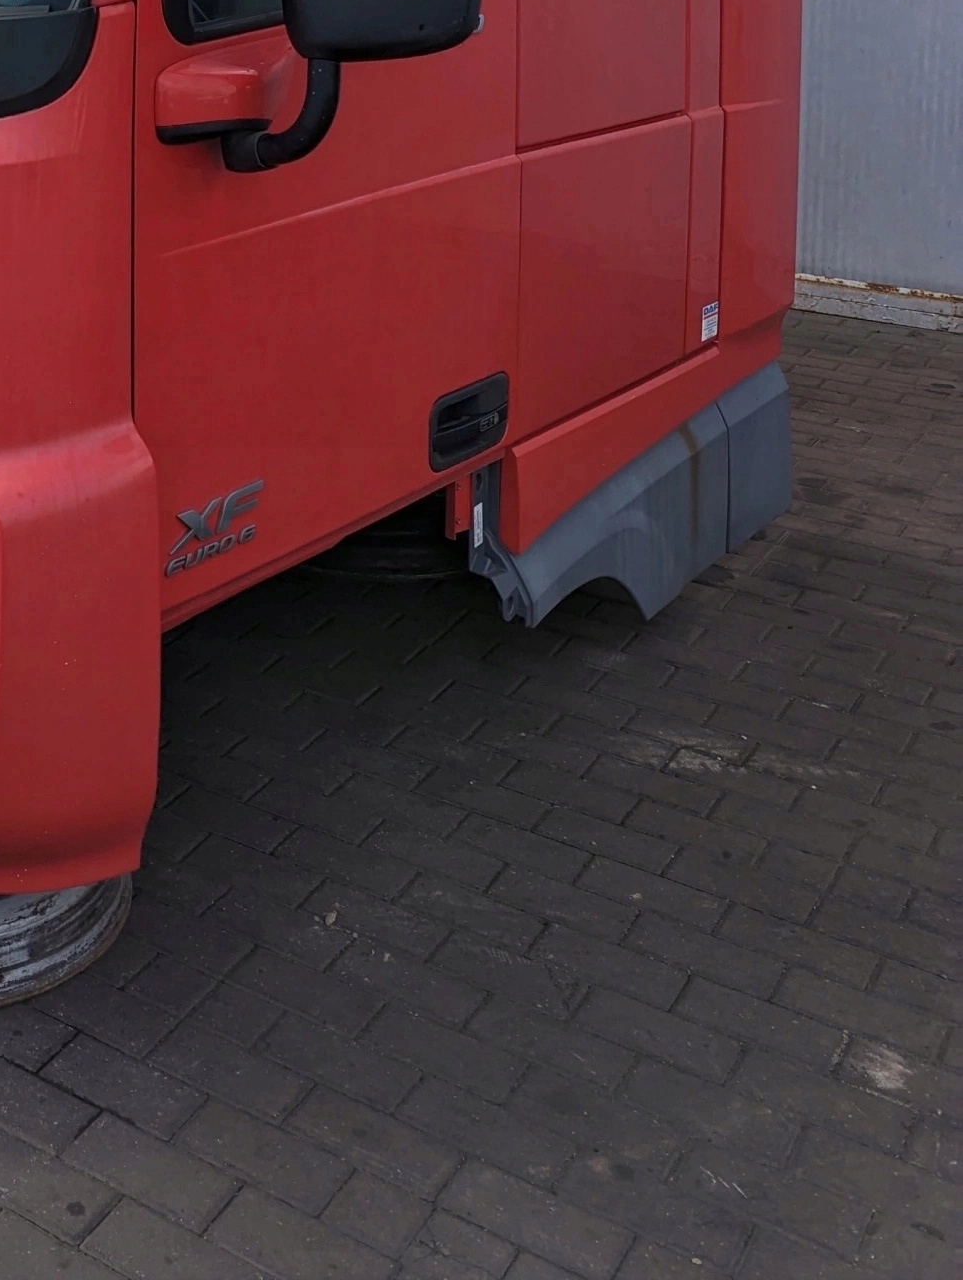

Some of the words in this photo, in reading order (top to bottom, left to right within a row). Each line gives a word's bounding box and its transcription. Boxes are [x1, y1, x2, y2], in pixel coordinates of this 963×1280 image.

[703, 303, 718, 316] DAF
[169, 479, 264, 555] XF
[165, 534, 236, 577] EURO
[238, 523, 256, 544] 6
